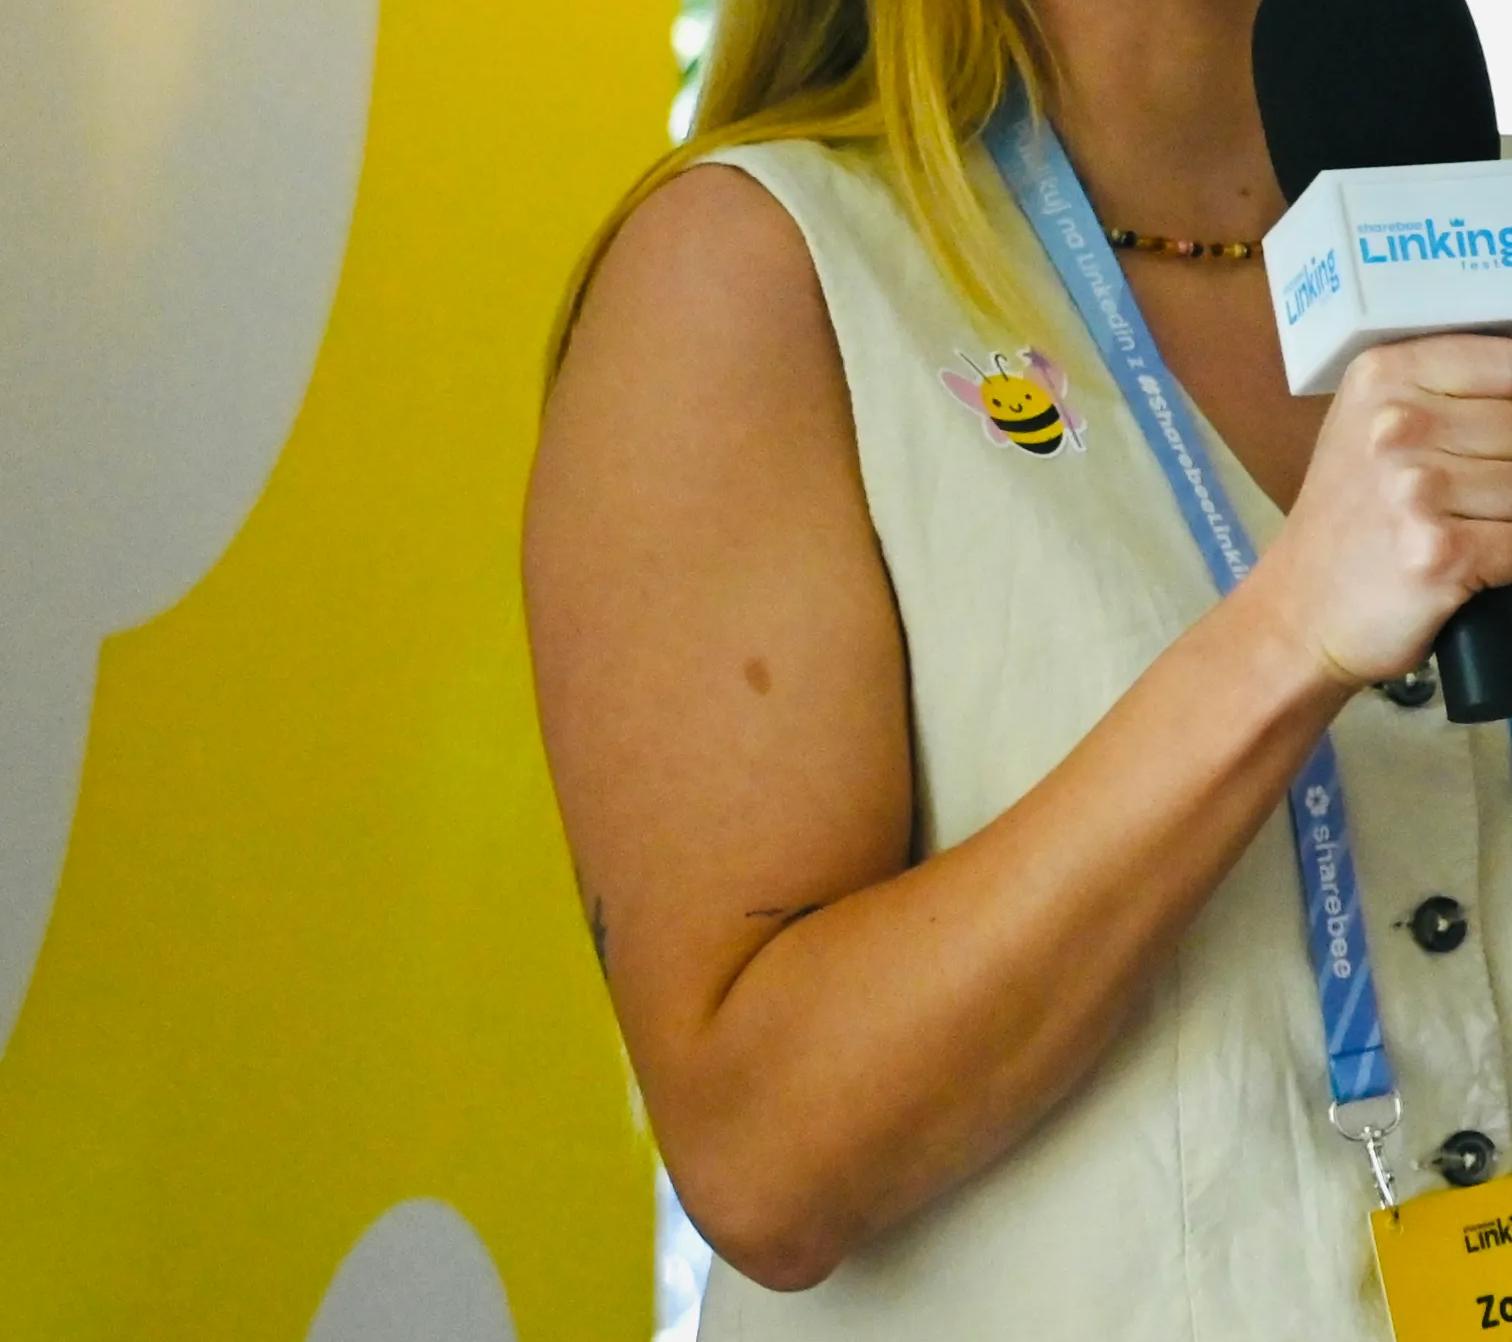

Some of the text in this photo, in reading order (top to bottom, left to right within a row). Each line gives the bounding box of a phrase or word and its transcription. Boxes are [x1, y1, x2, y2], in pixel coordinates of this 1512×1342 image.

[1057, 218, 1085, 249] na
[1285, 248, 1340, 326] Linking
[1312, 824, 1352, 980] sharebee
